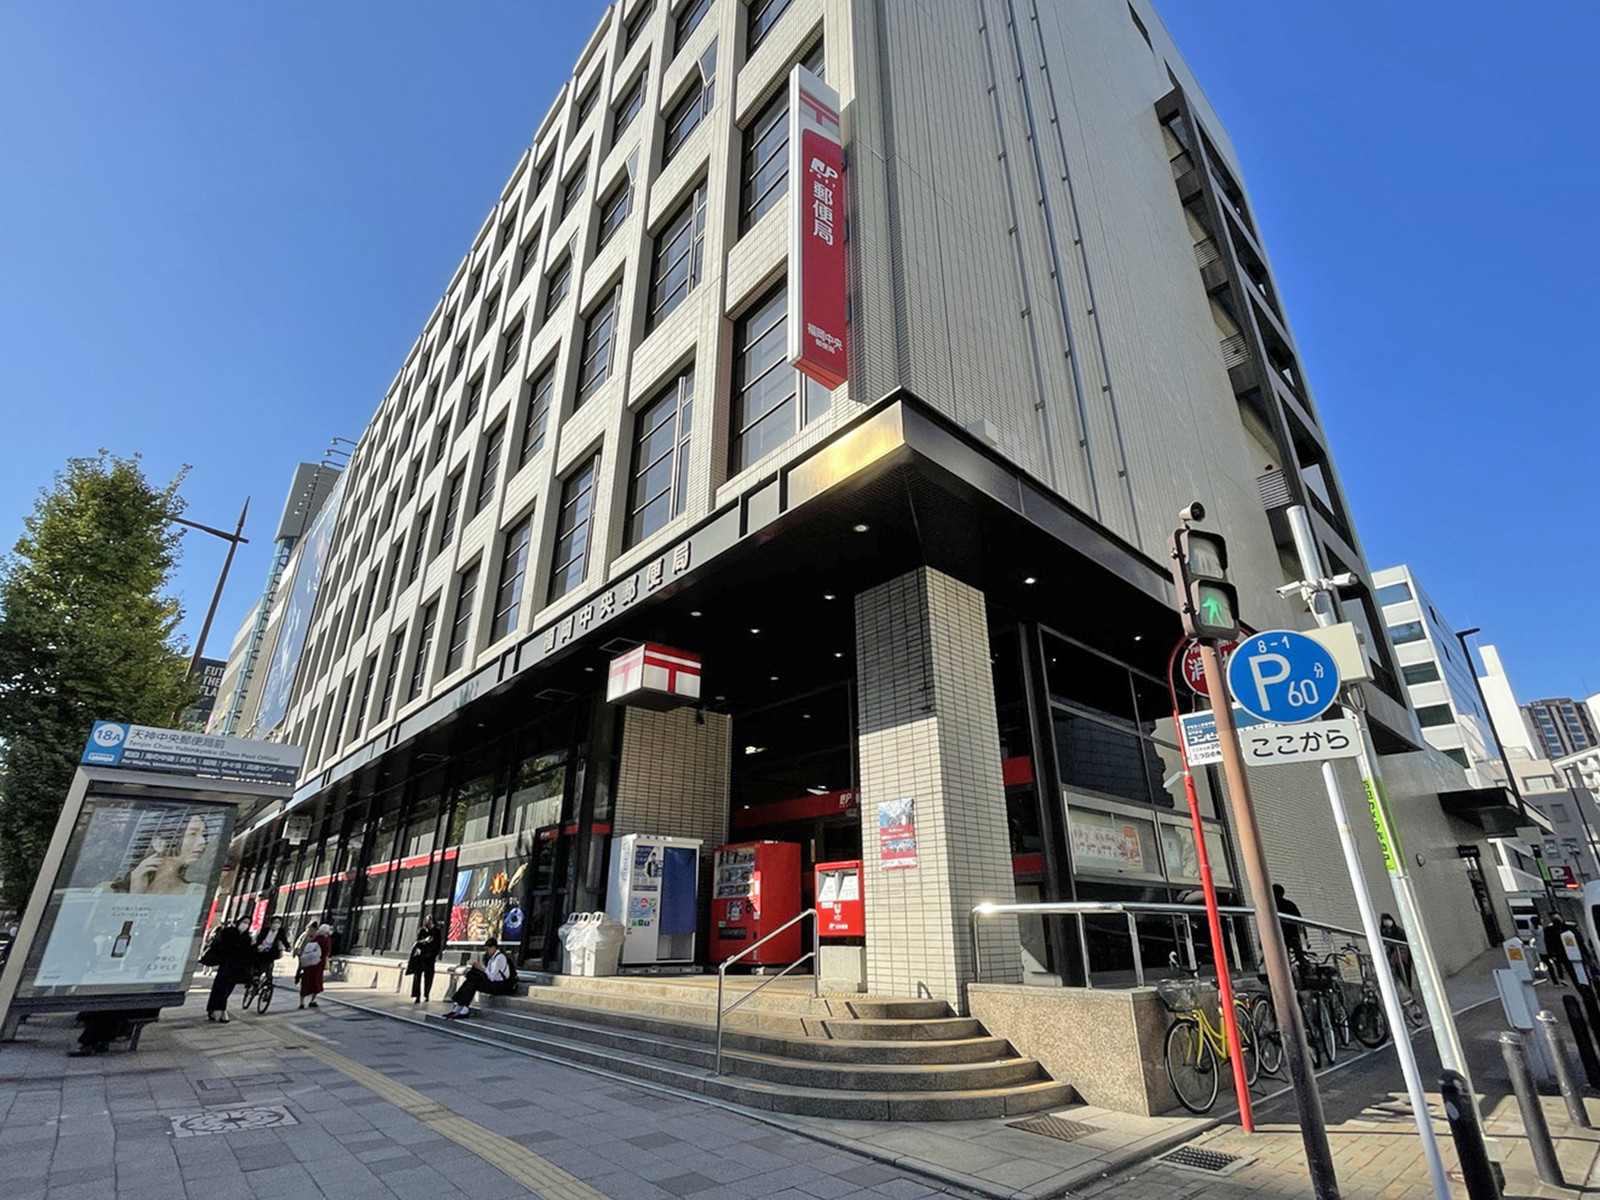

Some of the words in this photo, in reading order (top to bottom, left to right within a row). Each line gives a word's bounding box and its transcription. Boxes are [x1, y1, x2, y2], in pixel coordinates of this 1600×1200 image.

[812, 180, 835, 246] 郵便局
[542, 540, 691, 654] 福岡中央郵便局
[1256, 635, 1290, 654] 8-1
[1248, 653, 1291, 712] P
[96, 730, 121, 742] 18A
[132, 728, 225, 749] 天神中央郵便局前
[1252, 729, 1350, 758] ここから
